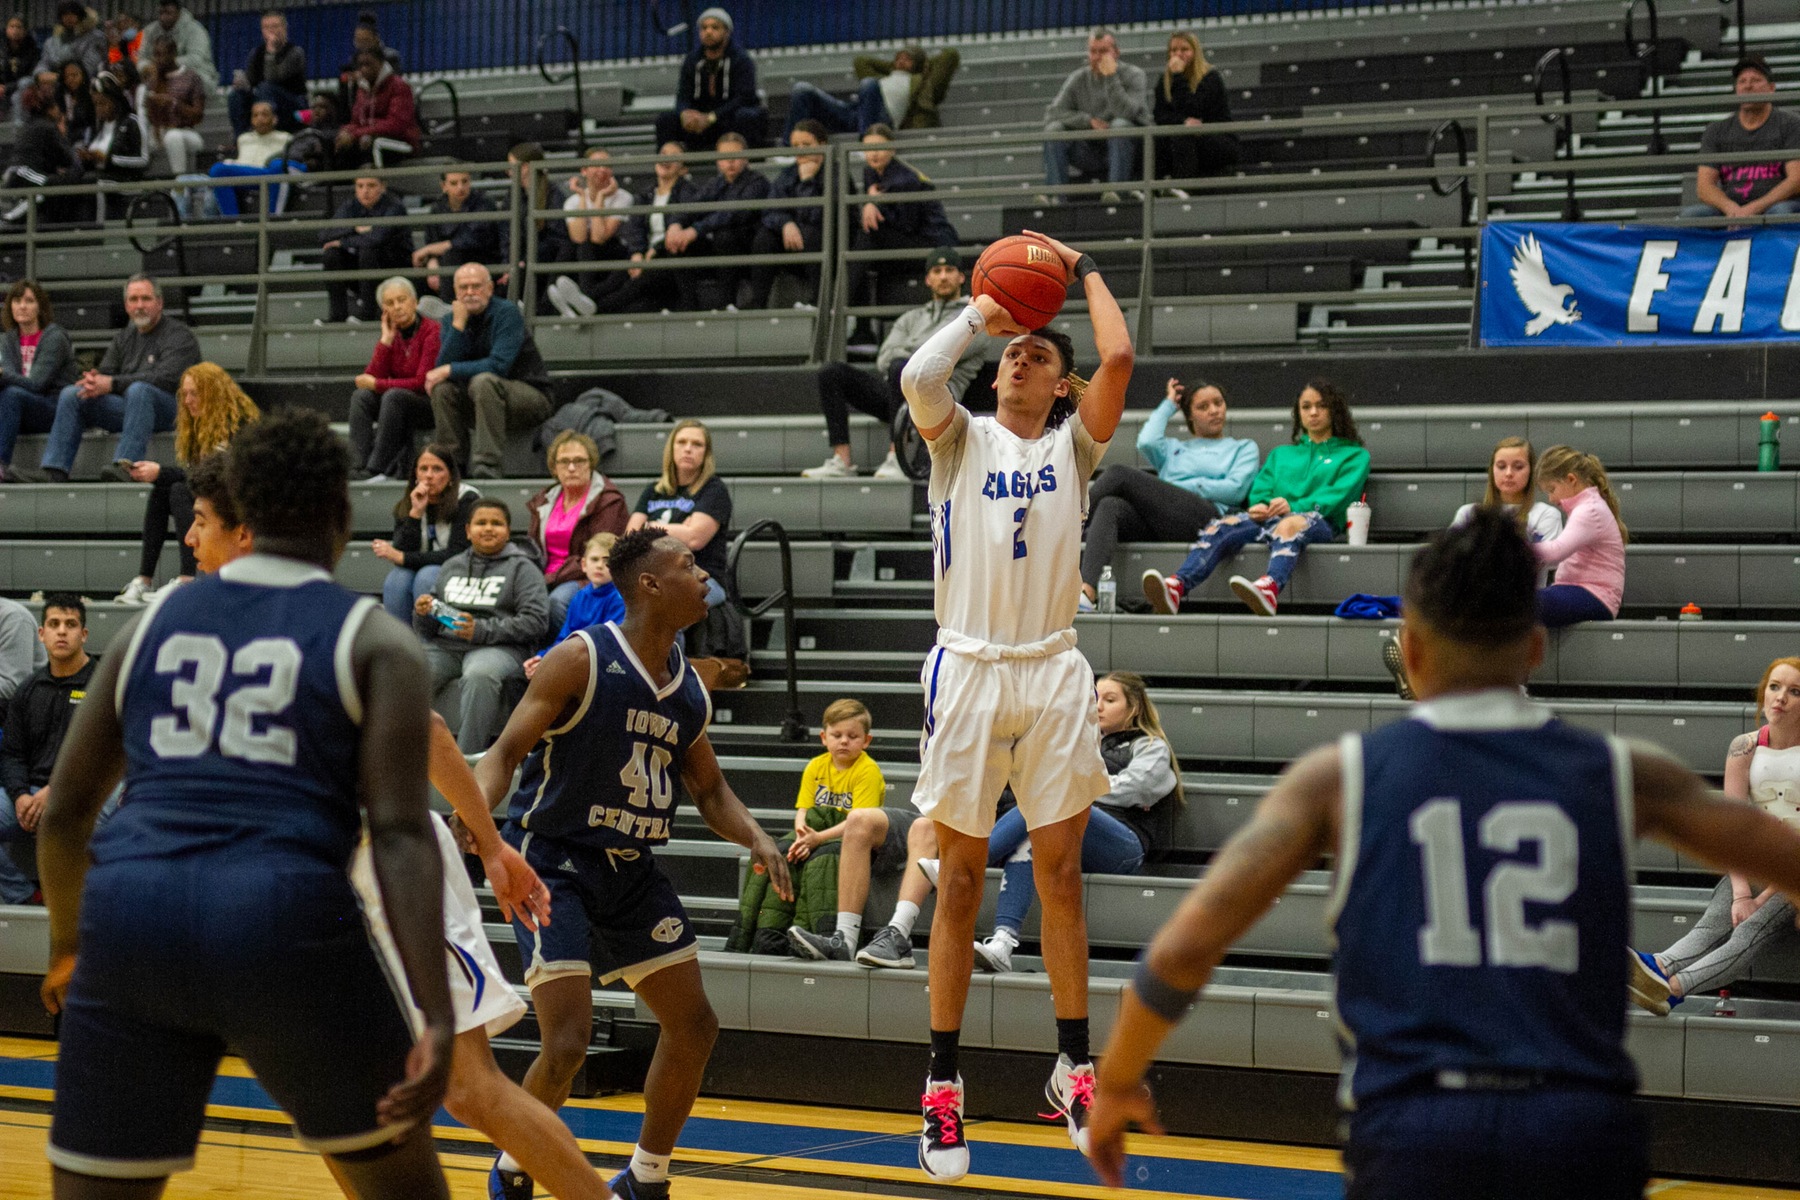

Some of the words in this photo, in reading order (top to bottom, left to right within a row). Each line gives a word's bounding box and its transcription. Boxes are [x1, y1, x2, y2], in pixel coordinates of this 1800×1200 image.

[1013, 508, 1027, 560] 2
[444, 576, 506, 606] NIKE
[149, 633, 303, 767] 32
[626, 708, 680, 746] IOWA
[619, 741, 673, 809] 40
[1408, 797, 1580, 974] 12
